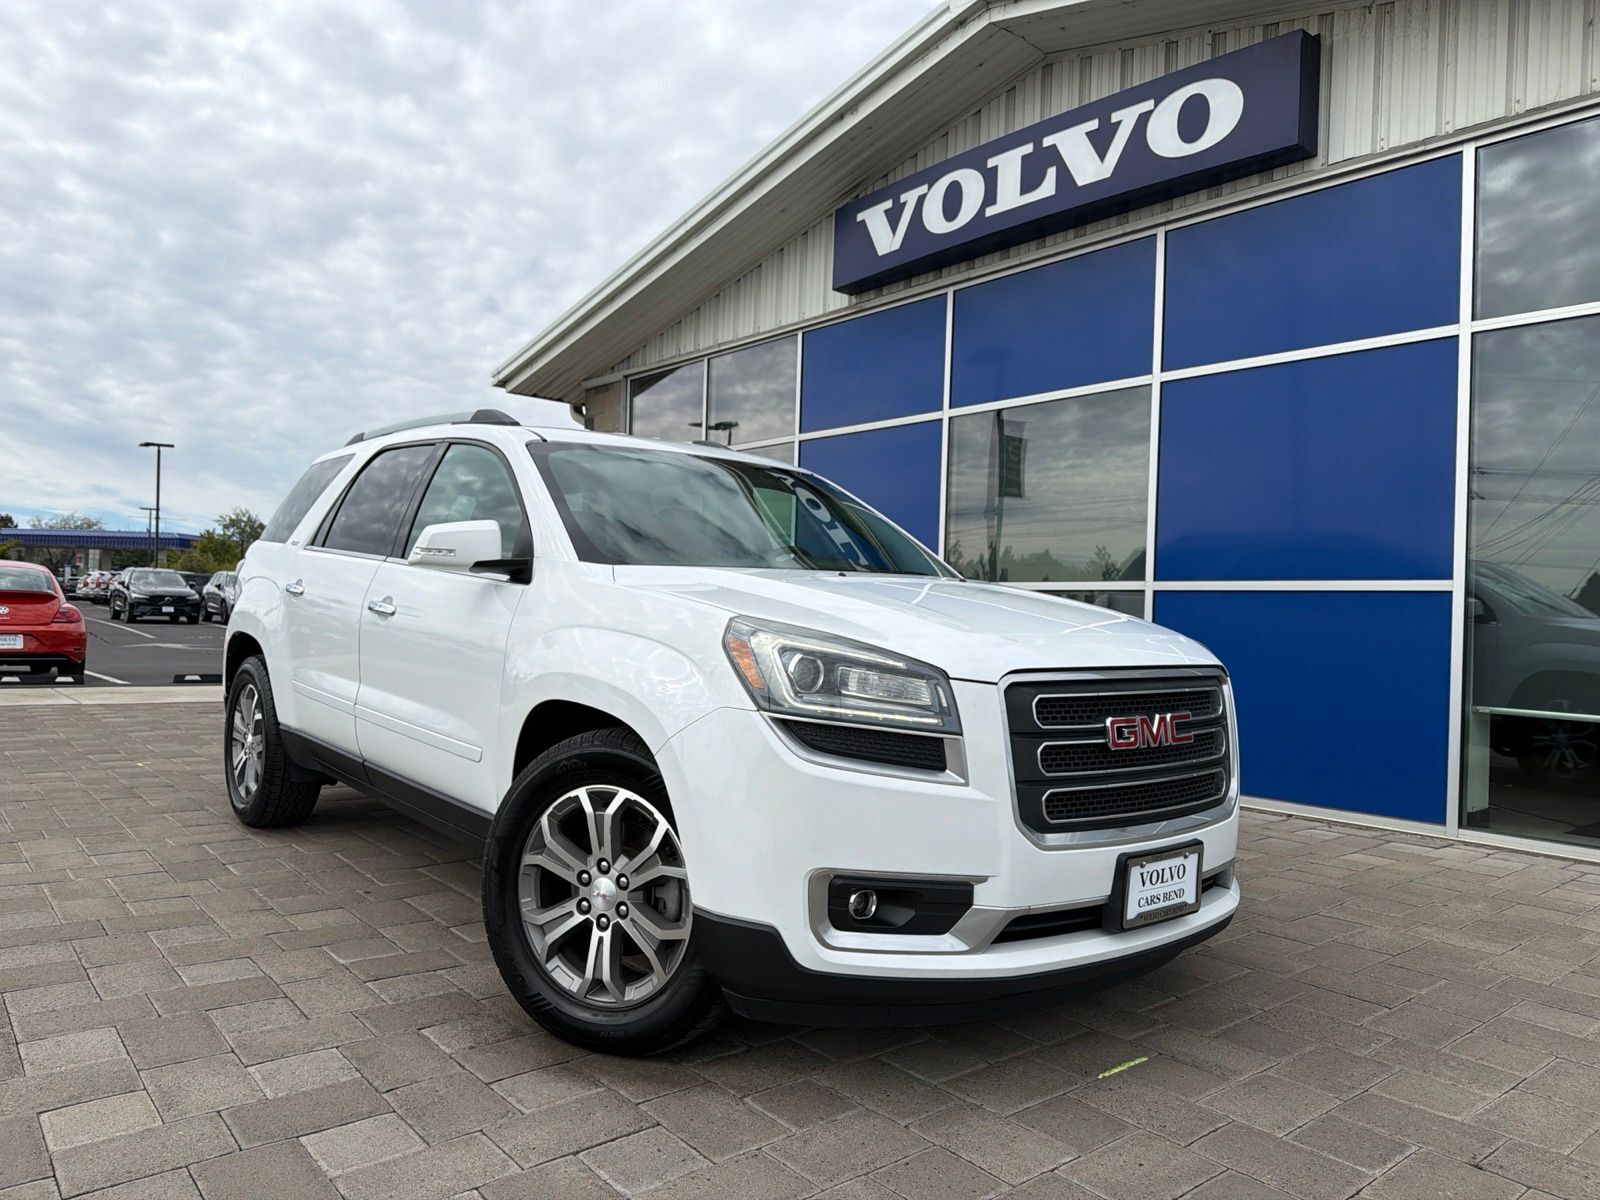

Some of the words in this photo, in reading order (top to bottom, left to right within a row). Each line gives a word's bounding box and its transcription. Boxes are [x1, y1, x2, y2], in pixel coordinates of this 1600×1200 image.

[855, 77, 1245, 257] VOLVO
[1105, 712, 1194, 750] GMC
[1139, 863, 1186, 887] VOLVO
[1137, 893, 1161, 908] CARS
[1162, 888, 1185, 903] BEND
[1143, 911, 1160, 921] VOLVO
[1160, 908, 1173, 918] CARS
